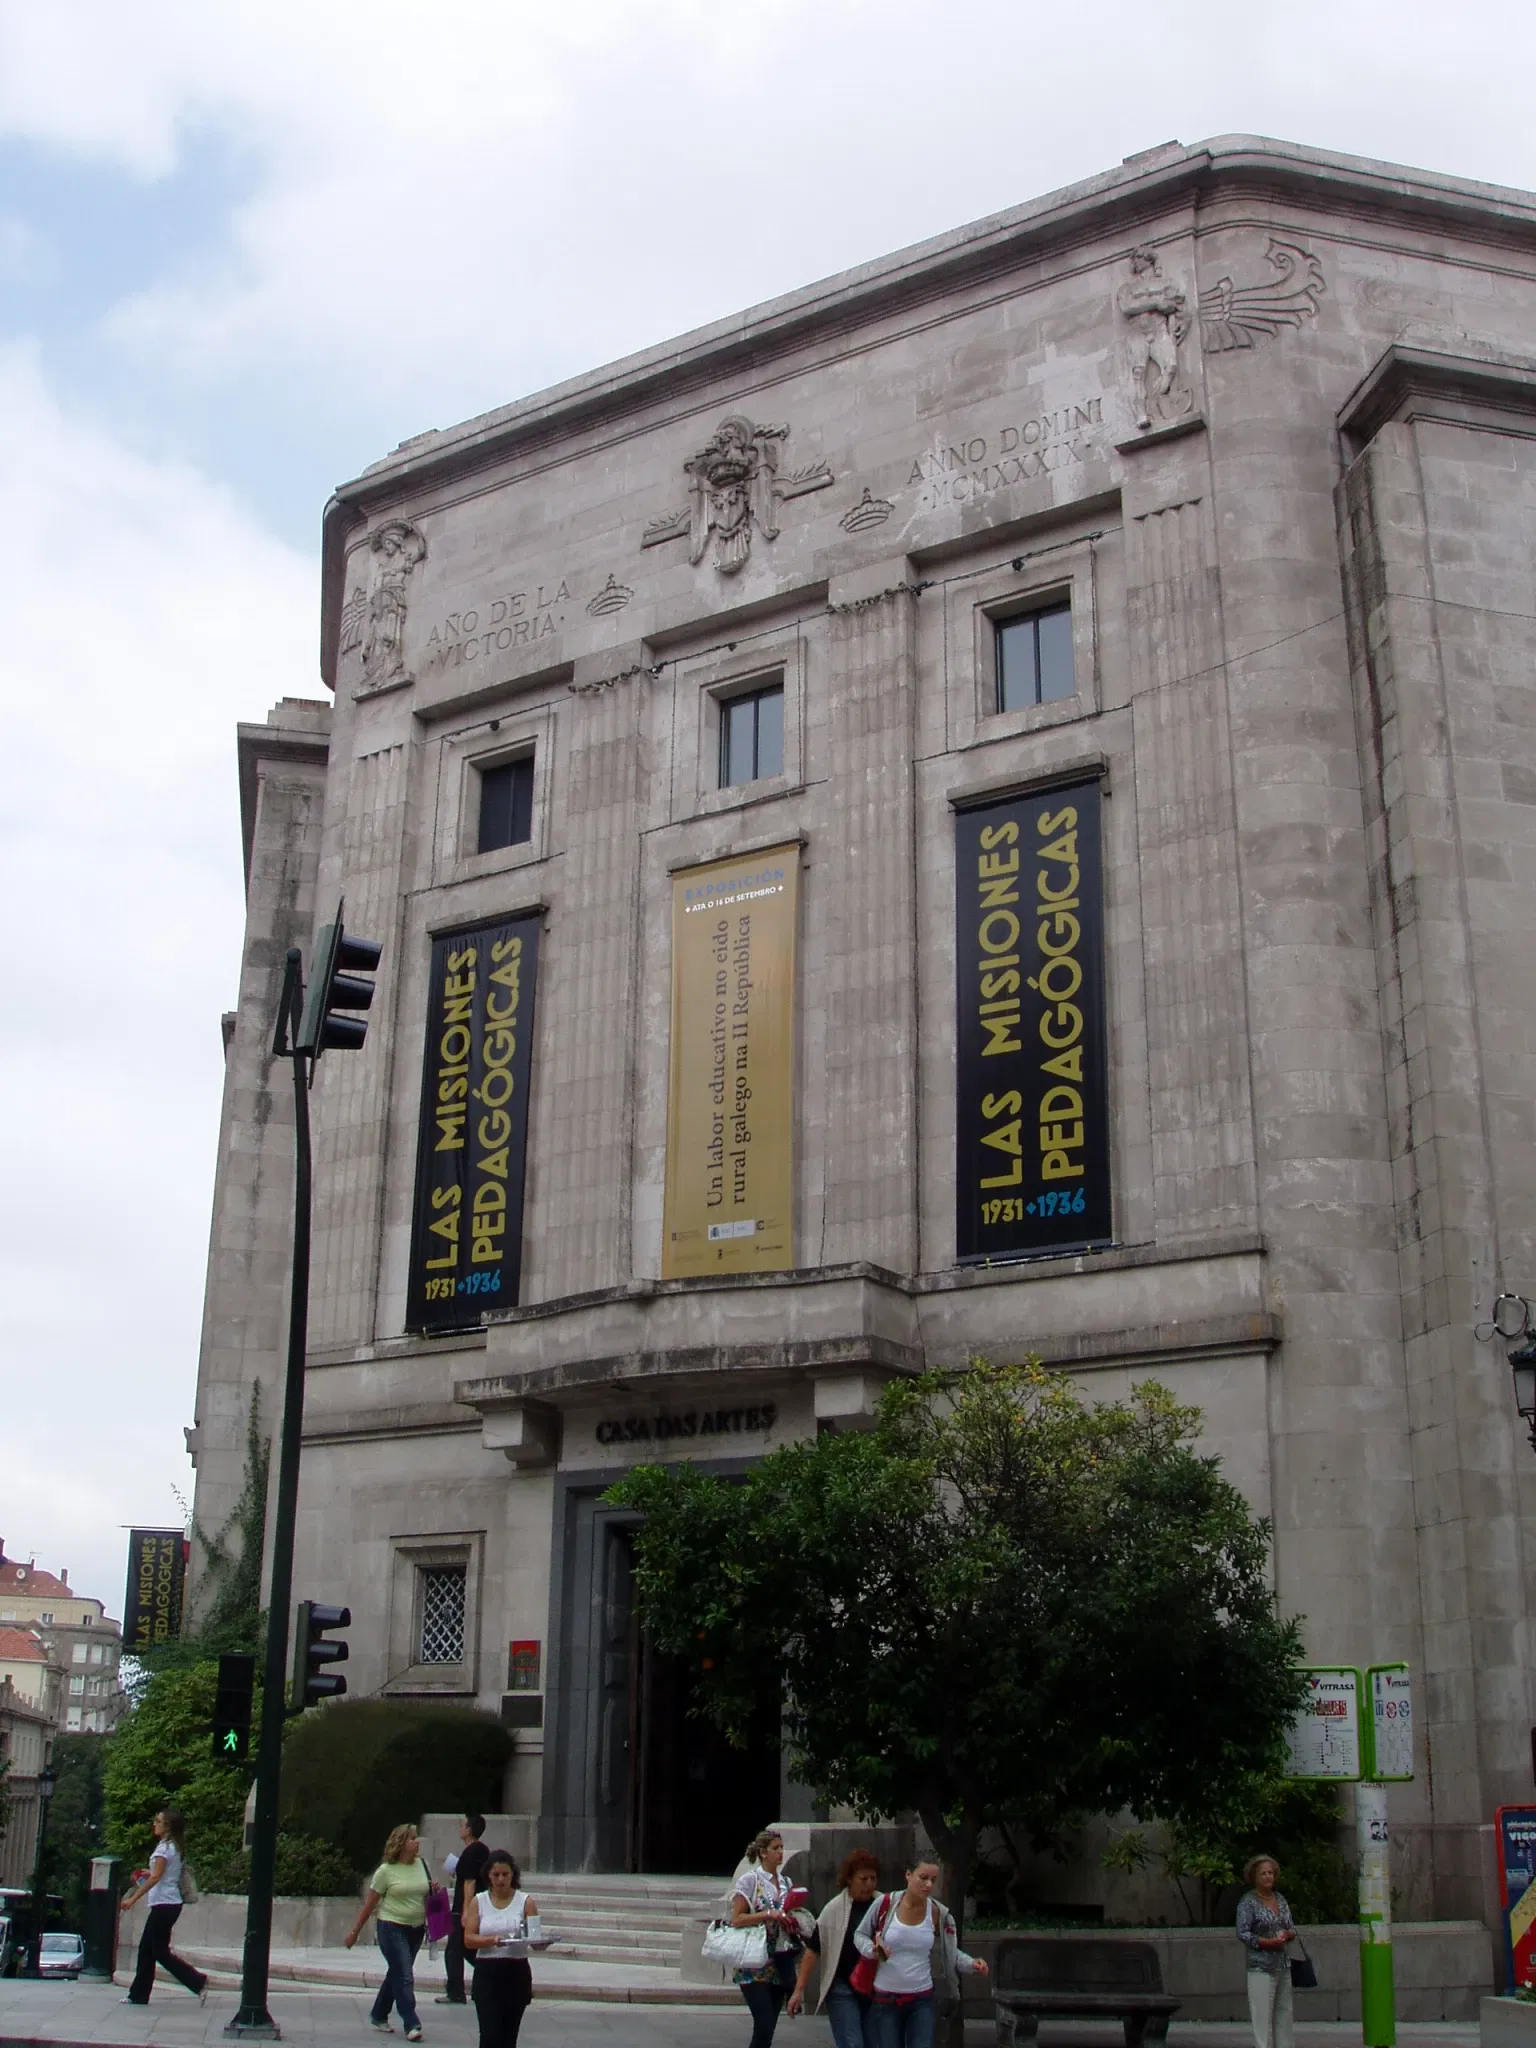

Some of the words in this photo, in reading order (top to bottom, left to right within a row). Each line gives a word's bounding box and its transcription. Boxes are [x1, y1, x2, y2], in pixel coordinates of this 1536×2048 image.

[906, 437, 987, 485] ANNO
[999, 397, 1104, 454] DOMINI
[426, 610, 479, 647] AÑO
[489, 592, 528, 625] DE
[536, 579, 571, 610] LA
[684, 867, 786, 901] EXPOSICIÓN
[692, 901, 707, 912] ATA
[707, 901, 714, 909] O
[724, 895, 735, 905] DE
[736, 886, 777, 902] SETEMBRO
[712, 920, 729, 963] eido
[732, 914, 753, 1016] República
[977, 820, 1023, 1058] MISIONES
[716, 969, 728, 997] no
[1026, 805, 1085, 1181] PEDAGÓGICAS
[434, 946, 477, 1153] MISIONES
[708, 1003, 726, 1105] educativo
[732, 1021, 748, 1040] II
[736, 1044, 748, 1069] na
[471, 935, 523, 1264] PEDAGÓGICAS
[730, 1076, 752, 1144] galego
[707, 1112, 724, 1169] labor
[980, 1088, 1024, 1189] LAS
[707, 1174, 723, 1208] Un
[729, 1149, 746, 1205] rural
[425, 1183, 462, 1271] LAS
[981, 1196, 1024, 1226] 1931
[1036, 1186, 1086, 1217] 1936
[424, 1276, 456, 1301] 1931
[465, 1268, 501, 1295] 1936
[595, 1415, 650, 1444] CASA
[700, 1400, 778, 1435] ARTES
[138, 1537, 157, 1606] MISIONES
[1319, 1683, 1355, 1691] VITRASA
